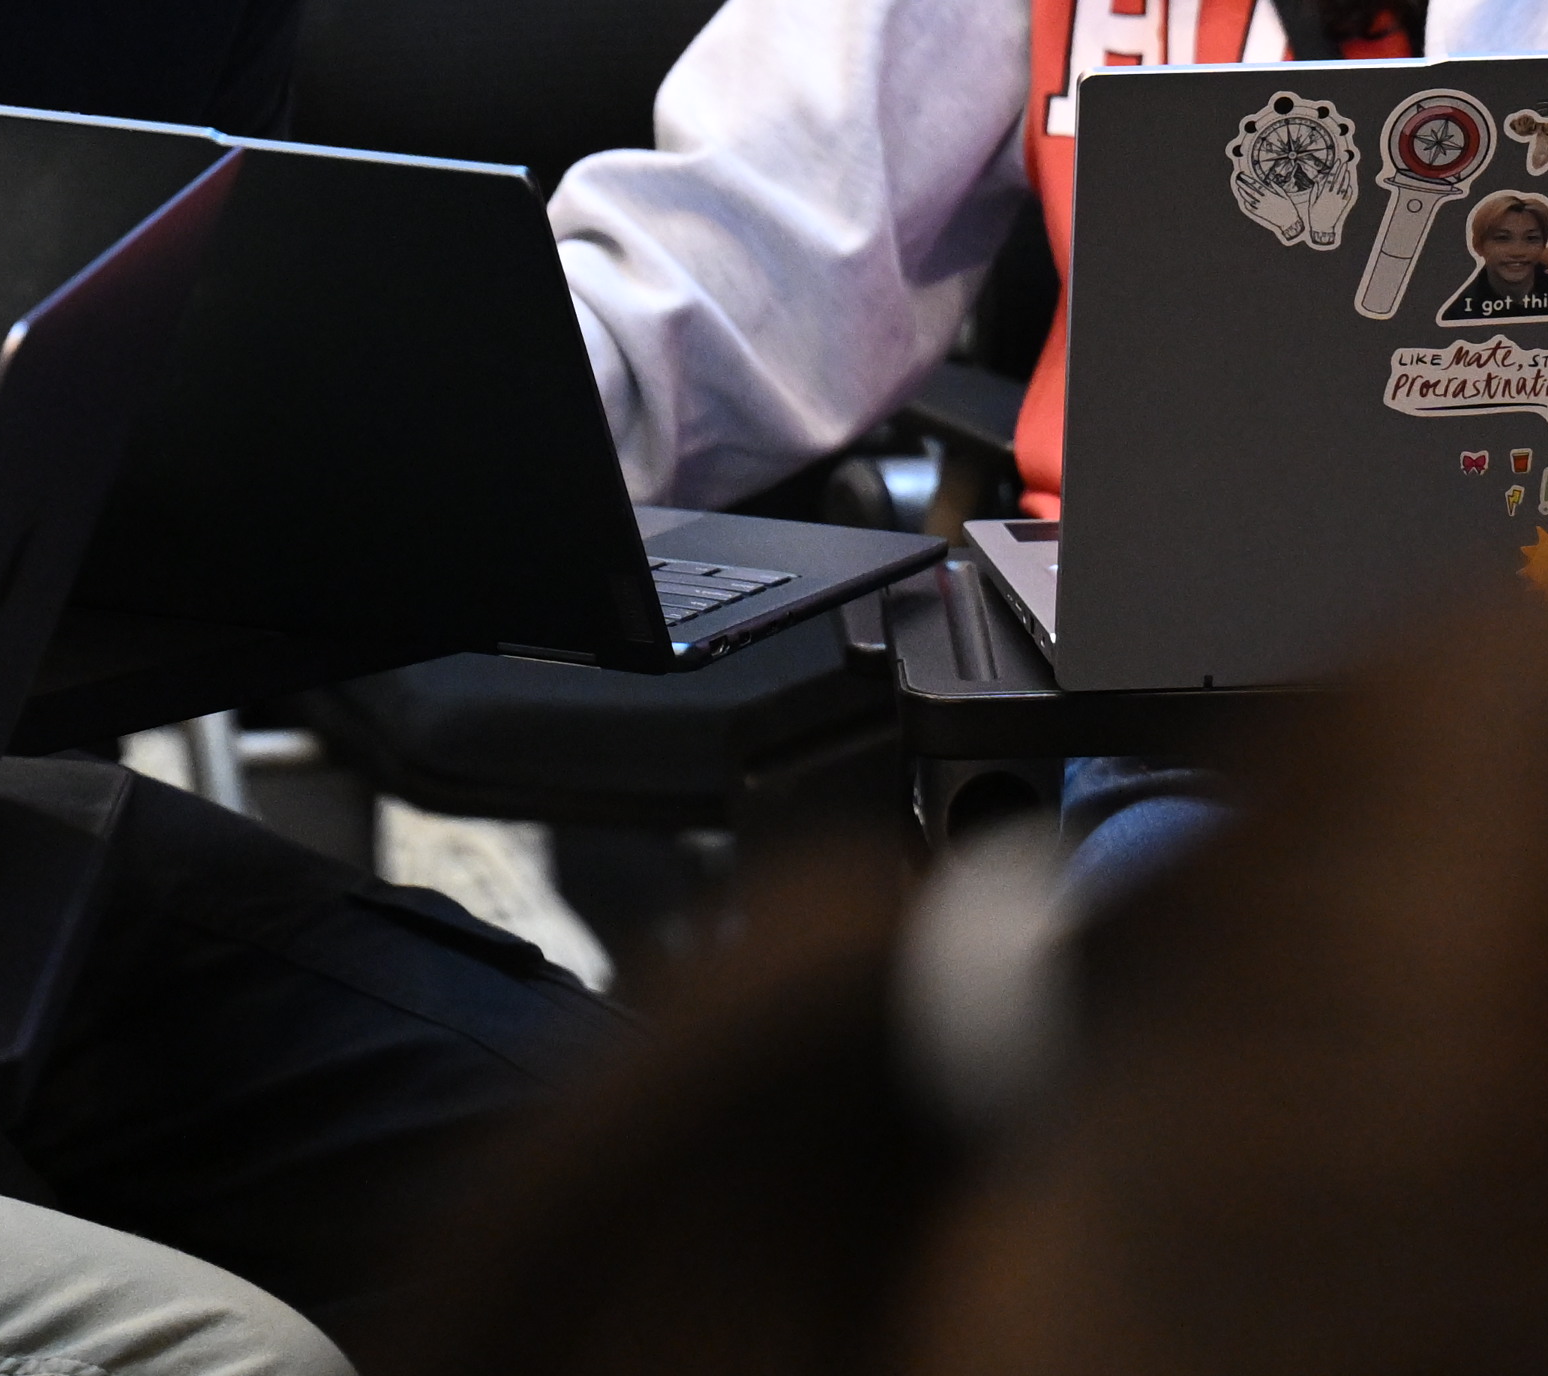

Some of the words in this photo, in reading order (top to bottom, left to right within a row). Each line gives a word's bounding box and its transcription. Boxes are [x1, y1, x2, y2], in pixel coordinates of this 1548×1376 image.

[1464, 298, 1473, 312] I
[1481, 295, 1513, 316] got
[1398, 353, 1443, 367] LIKE
